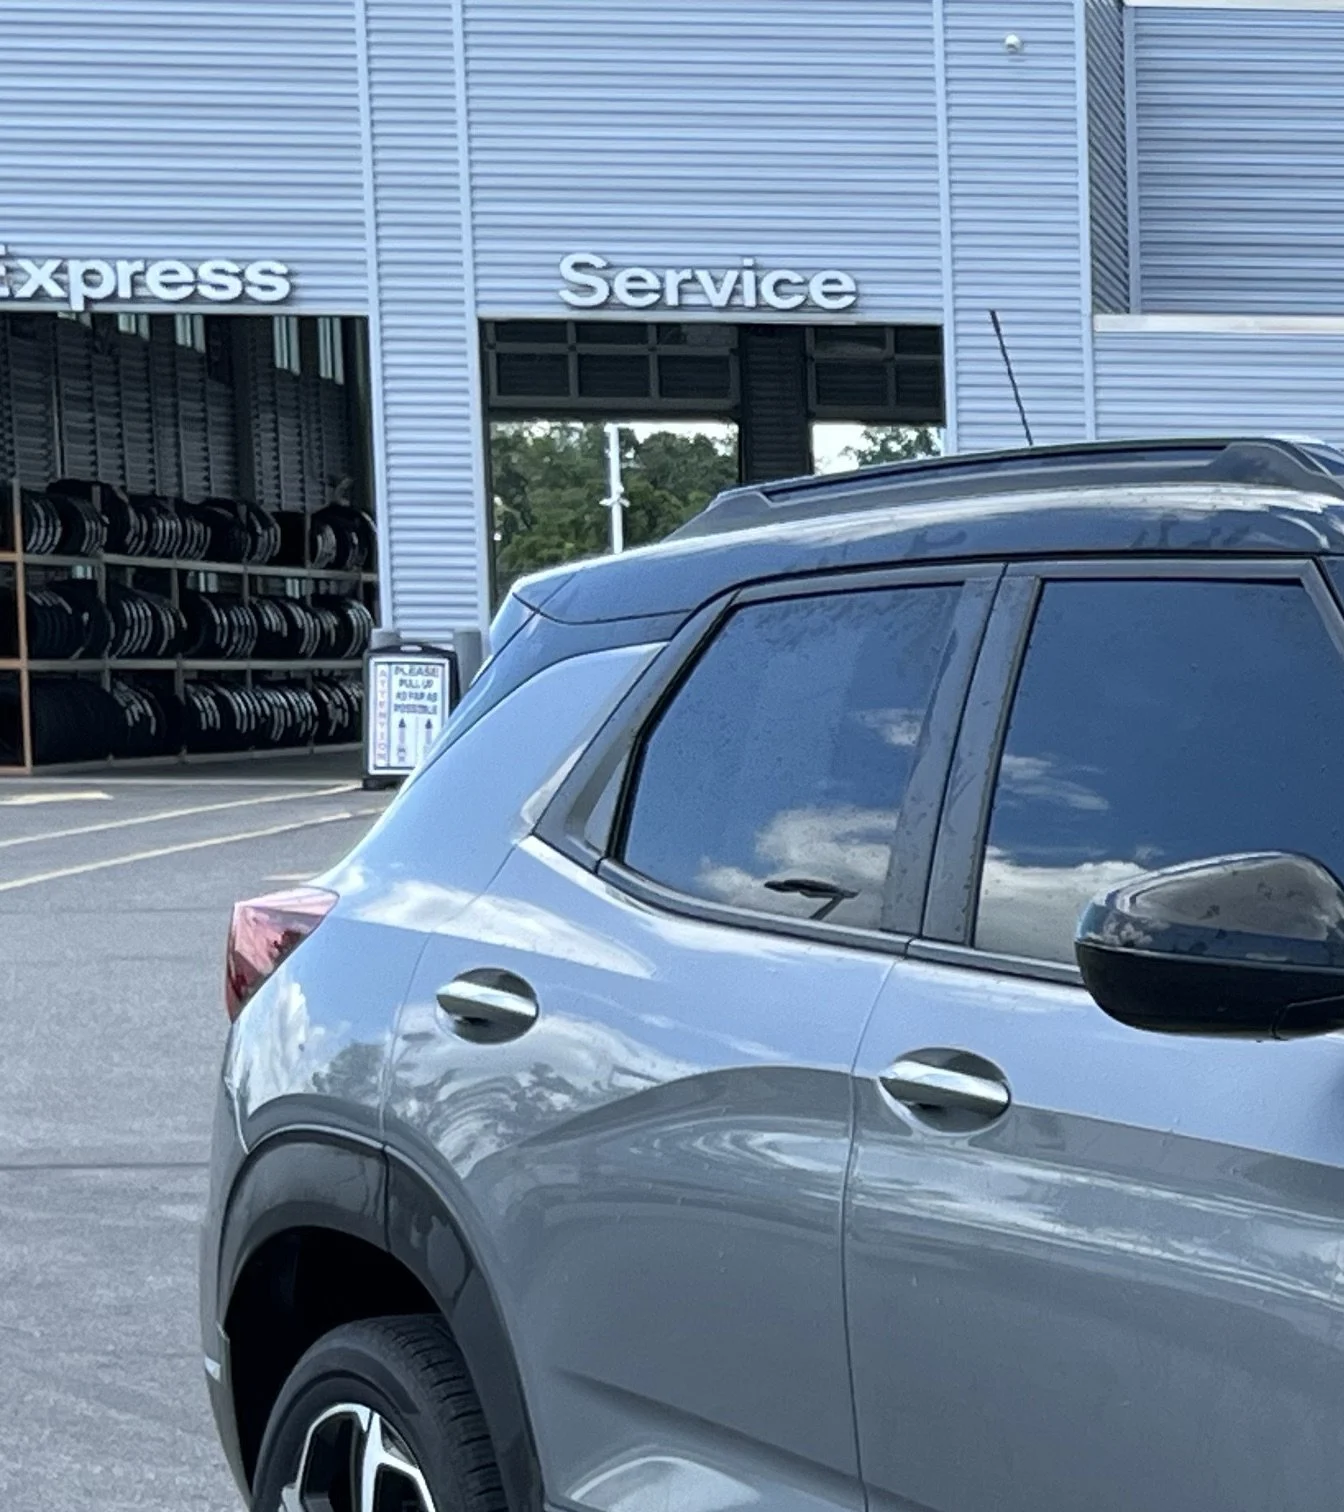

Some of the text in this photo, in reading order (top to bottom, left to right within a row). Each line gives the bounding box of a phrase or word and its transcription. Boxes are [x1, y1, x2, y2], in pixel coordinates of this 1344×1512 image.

[0, 244, 291, 311] xpress
[558, 252, 857, 309] Service
[394, 665, 440, 677] PLEASE
